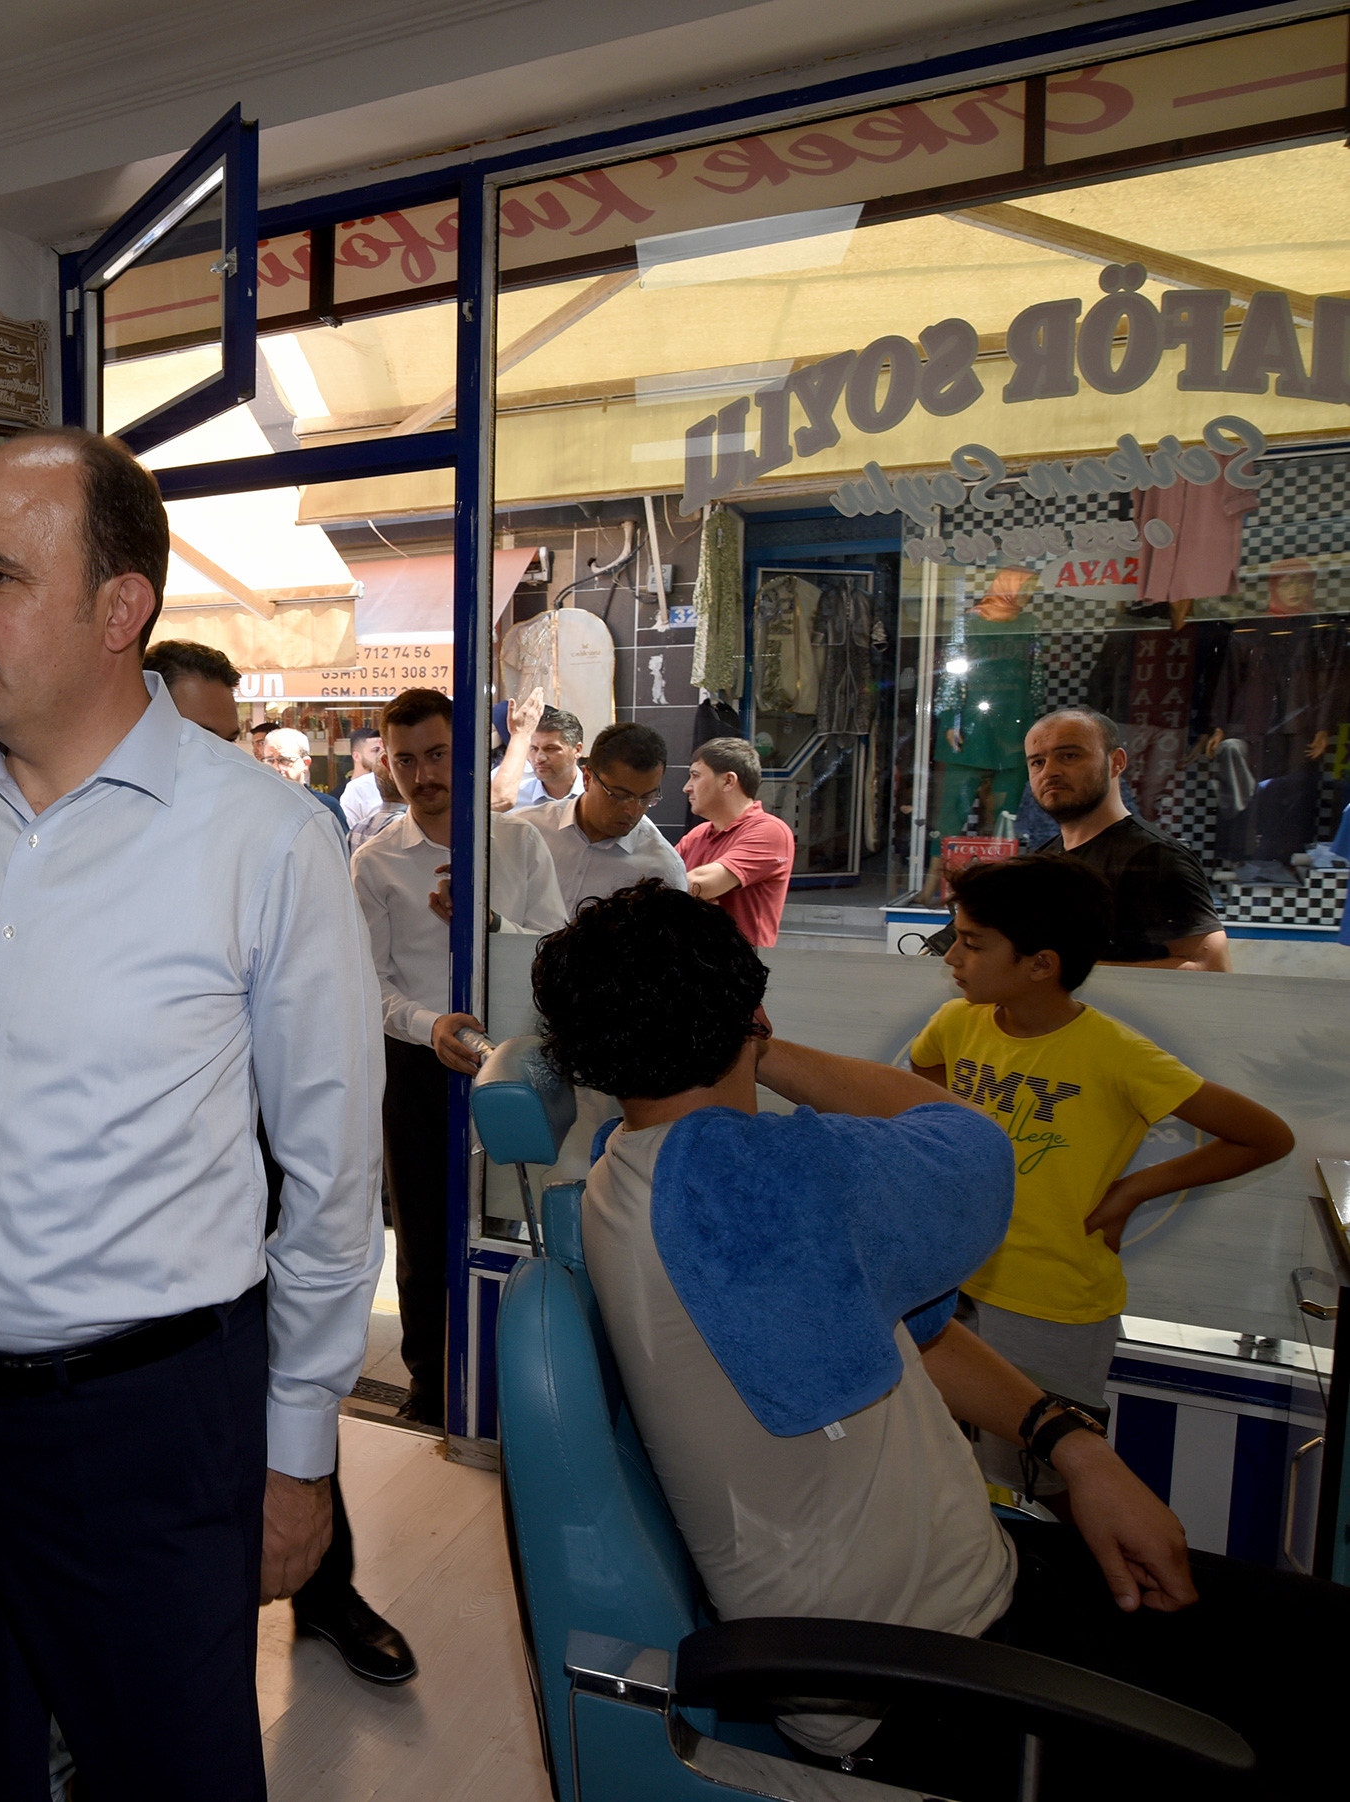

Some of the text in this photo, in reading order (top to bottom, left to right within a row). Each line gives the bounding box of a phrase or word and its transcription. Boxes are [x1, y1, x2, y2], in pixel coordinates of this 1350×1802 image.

[363, 646, 389, 660] 712
[393, 646, 410, 659] 74
[414, 646, 432, 659] 56
[360, 666, 368, 679] 0
[371, 666, 397, 679] 541
[401, 665, 427, 678] 308
[431, 665, 449, 678] 37
[321, 687, 357, 698] GSM:
[360, 687, 368, 697] 0
[371, 687, 398, 697] 532
[953, 844, 1007, 857] FOR YOU
[989, 1097, 1070, 1175] llege
